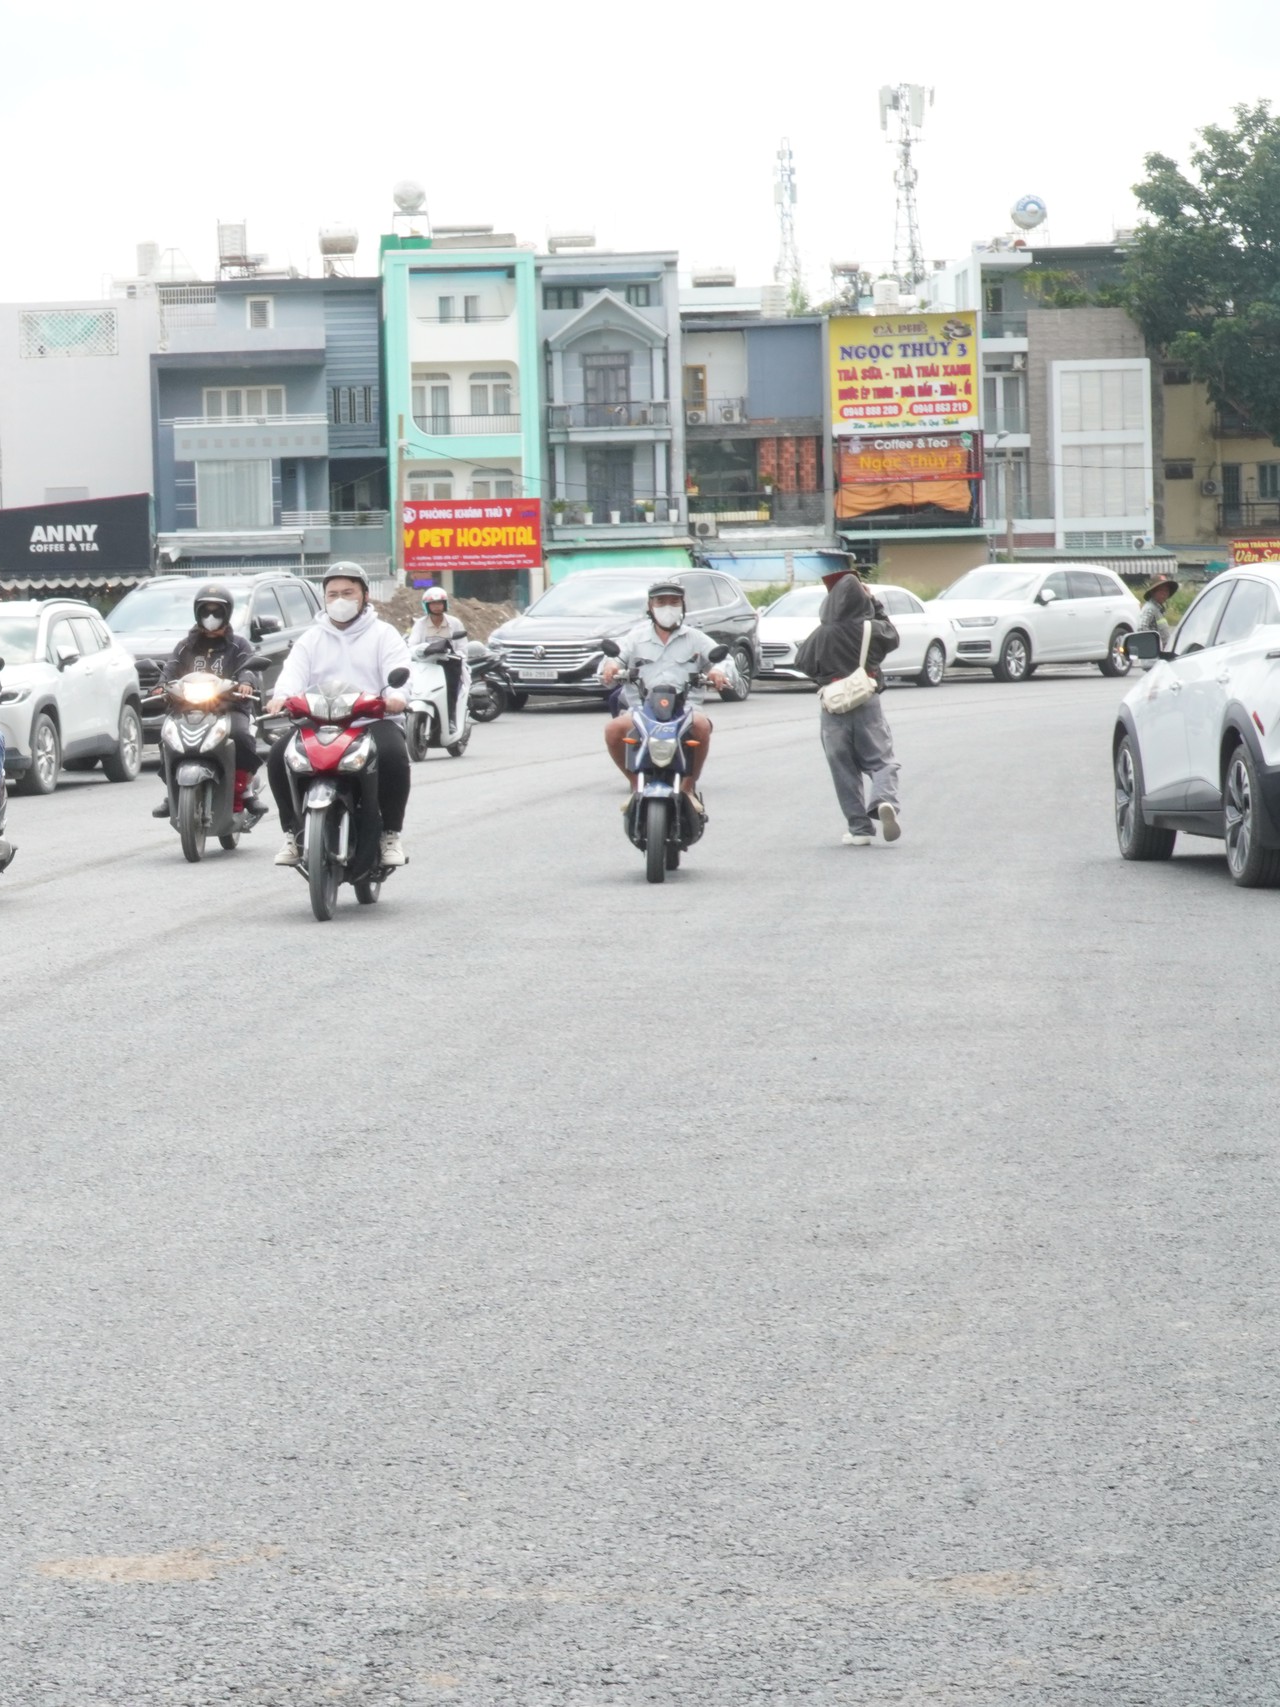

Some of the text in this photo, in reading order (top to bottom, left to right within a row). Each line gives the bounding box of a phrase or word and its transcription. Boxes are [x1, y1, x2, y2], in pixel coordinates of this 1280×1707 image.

[840, 336, 967, 363] NGỌC THỦY 3
[874, 438, 948, 450] Coffee & Tea
[954, 453, 962, 466] 3
[419, 507, 452, 519] PHÒNG
[454, 507, 482, 519] KHÁM
[504, 508, 512, 517] Y
[30, 524, 98, 542] ANNY
[418, 528, 453, 548] PET
[456, 526, 537, 547] HOSPITAL
[29, 543, 99, 553] COFFEE & TEA
[1261, 549, 1280, 562] Sa
